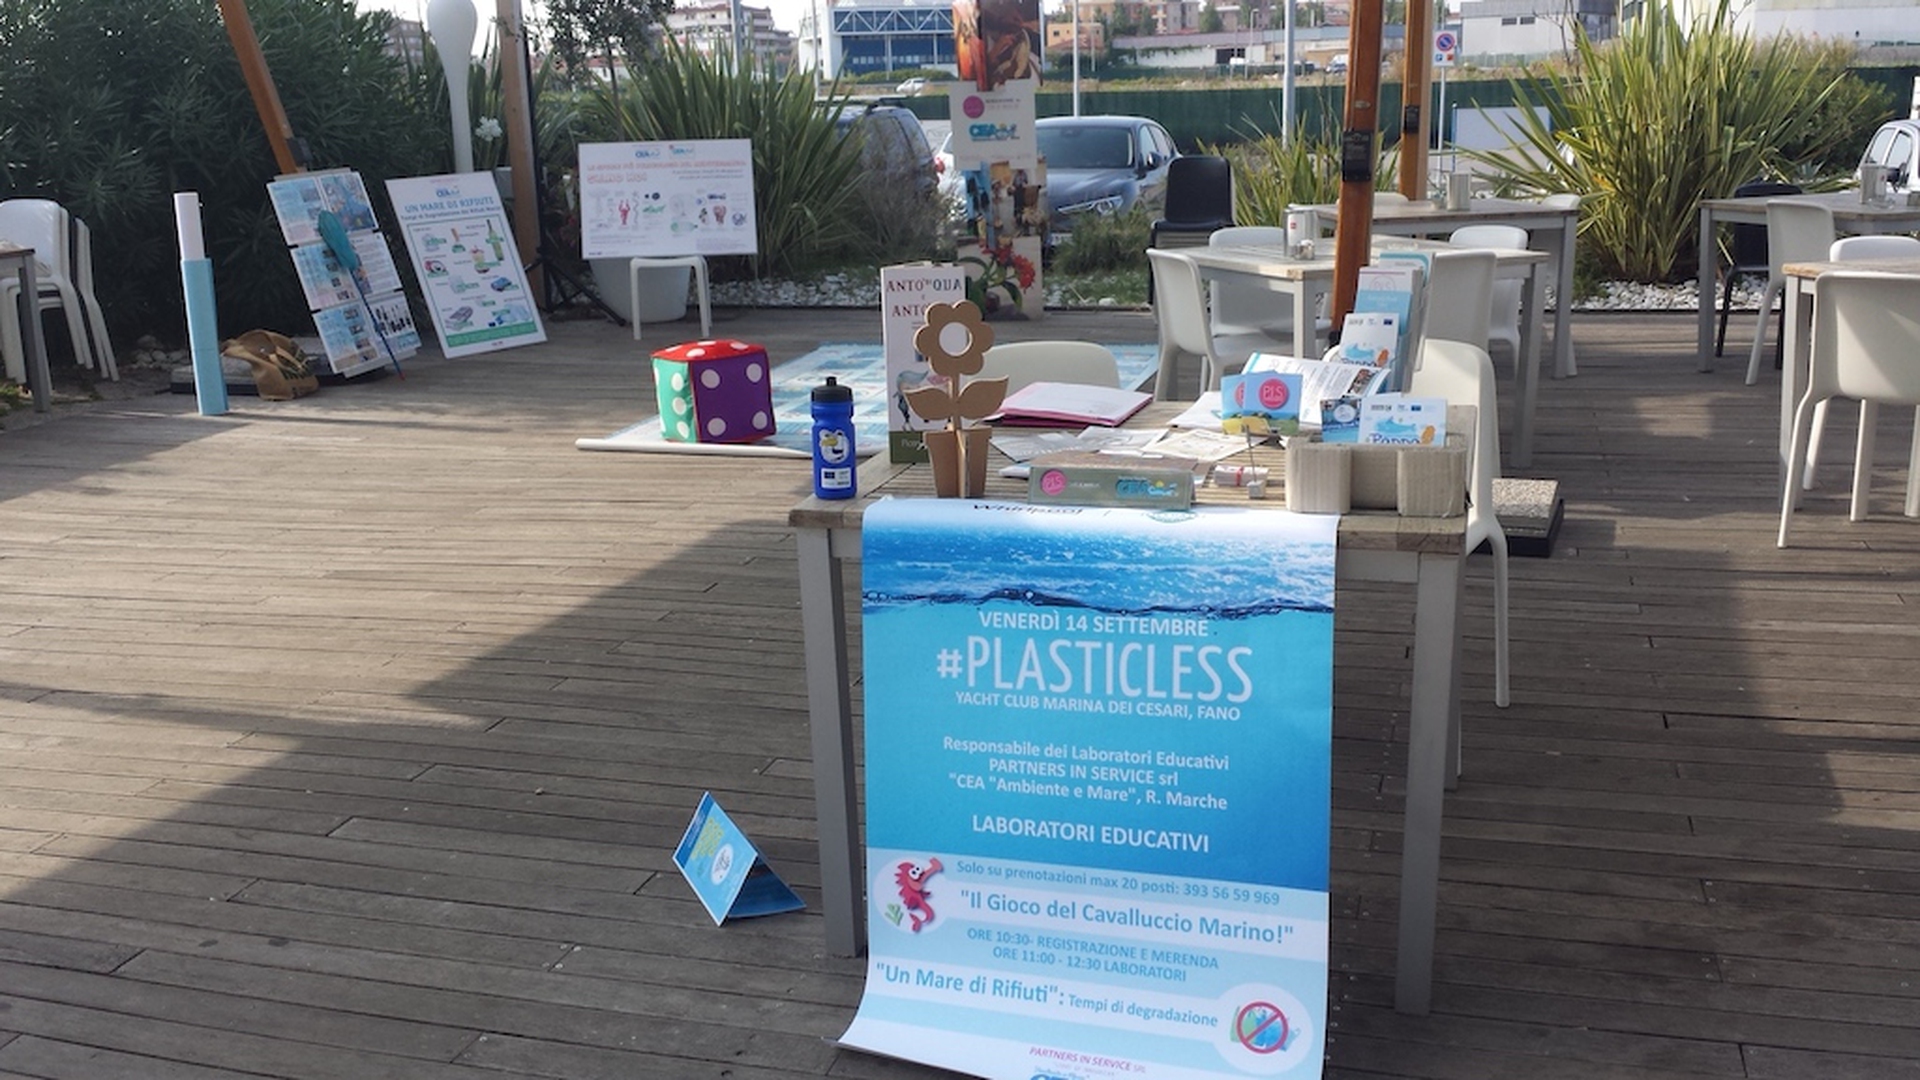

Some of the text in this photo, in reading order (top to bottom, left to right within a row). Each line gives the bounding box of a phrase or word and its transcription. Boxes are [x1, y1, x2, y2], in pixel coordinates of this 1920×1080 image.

[405, 204, 419, 213] UN
[420, 202, 445, 212] MARE
[974, 503, 1083, 514] Whirlpool
[978, 610, 1209, 636] VENERDÌ 14 SETTEMBRE
[937, 635, 1253, 703] #PLASTICLESS
[955, 691, 1240, 721] YACHT CLUB MARINA DEI CESARI, FANO
[943, 736, 1230, 770] Responsabile dei Laboratori Educativi
[989, 758, 1178, 786] PARTNERS IN SERVICE srl
[949, 773, 1228, 810] "CEA "Ambiente e Mare", R. Marche
[972, 814, 1209, 853] LABORATORI EDUCATIVI
[957, 861, 1280, 905] Solo su prenotazioni max 20 posti: 393 56 59 969
[961, 890, 1293, 944] "Il Gioco del Cavalluccio Marino!"
[967, 927, 1219, 969] ORE 10:30- REGISTRAZIONE E MERENDA
[993, 946, 1018, 960] ORE
[1022, 950, 1055, 965] 11:00
[1067, 956, 1101, 971] 12:30
[1104, 960, 1186, 982] LABORATORI
[876, 963, 1219, 1027] "Un Mare di Rifiuti": Tempi di degradazione
[1029, 1047, 1078, 1061] PARTNERS
[1080, 1055, 1091, 1064] IN
[1092, 1057, 1131, 1071] SERVICE
